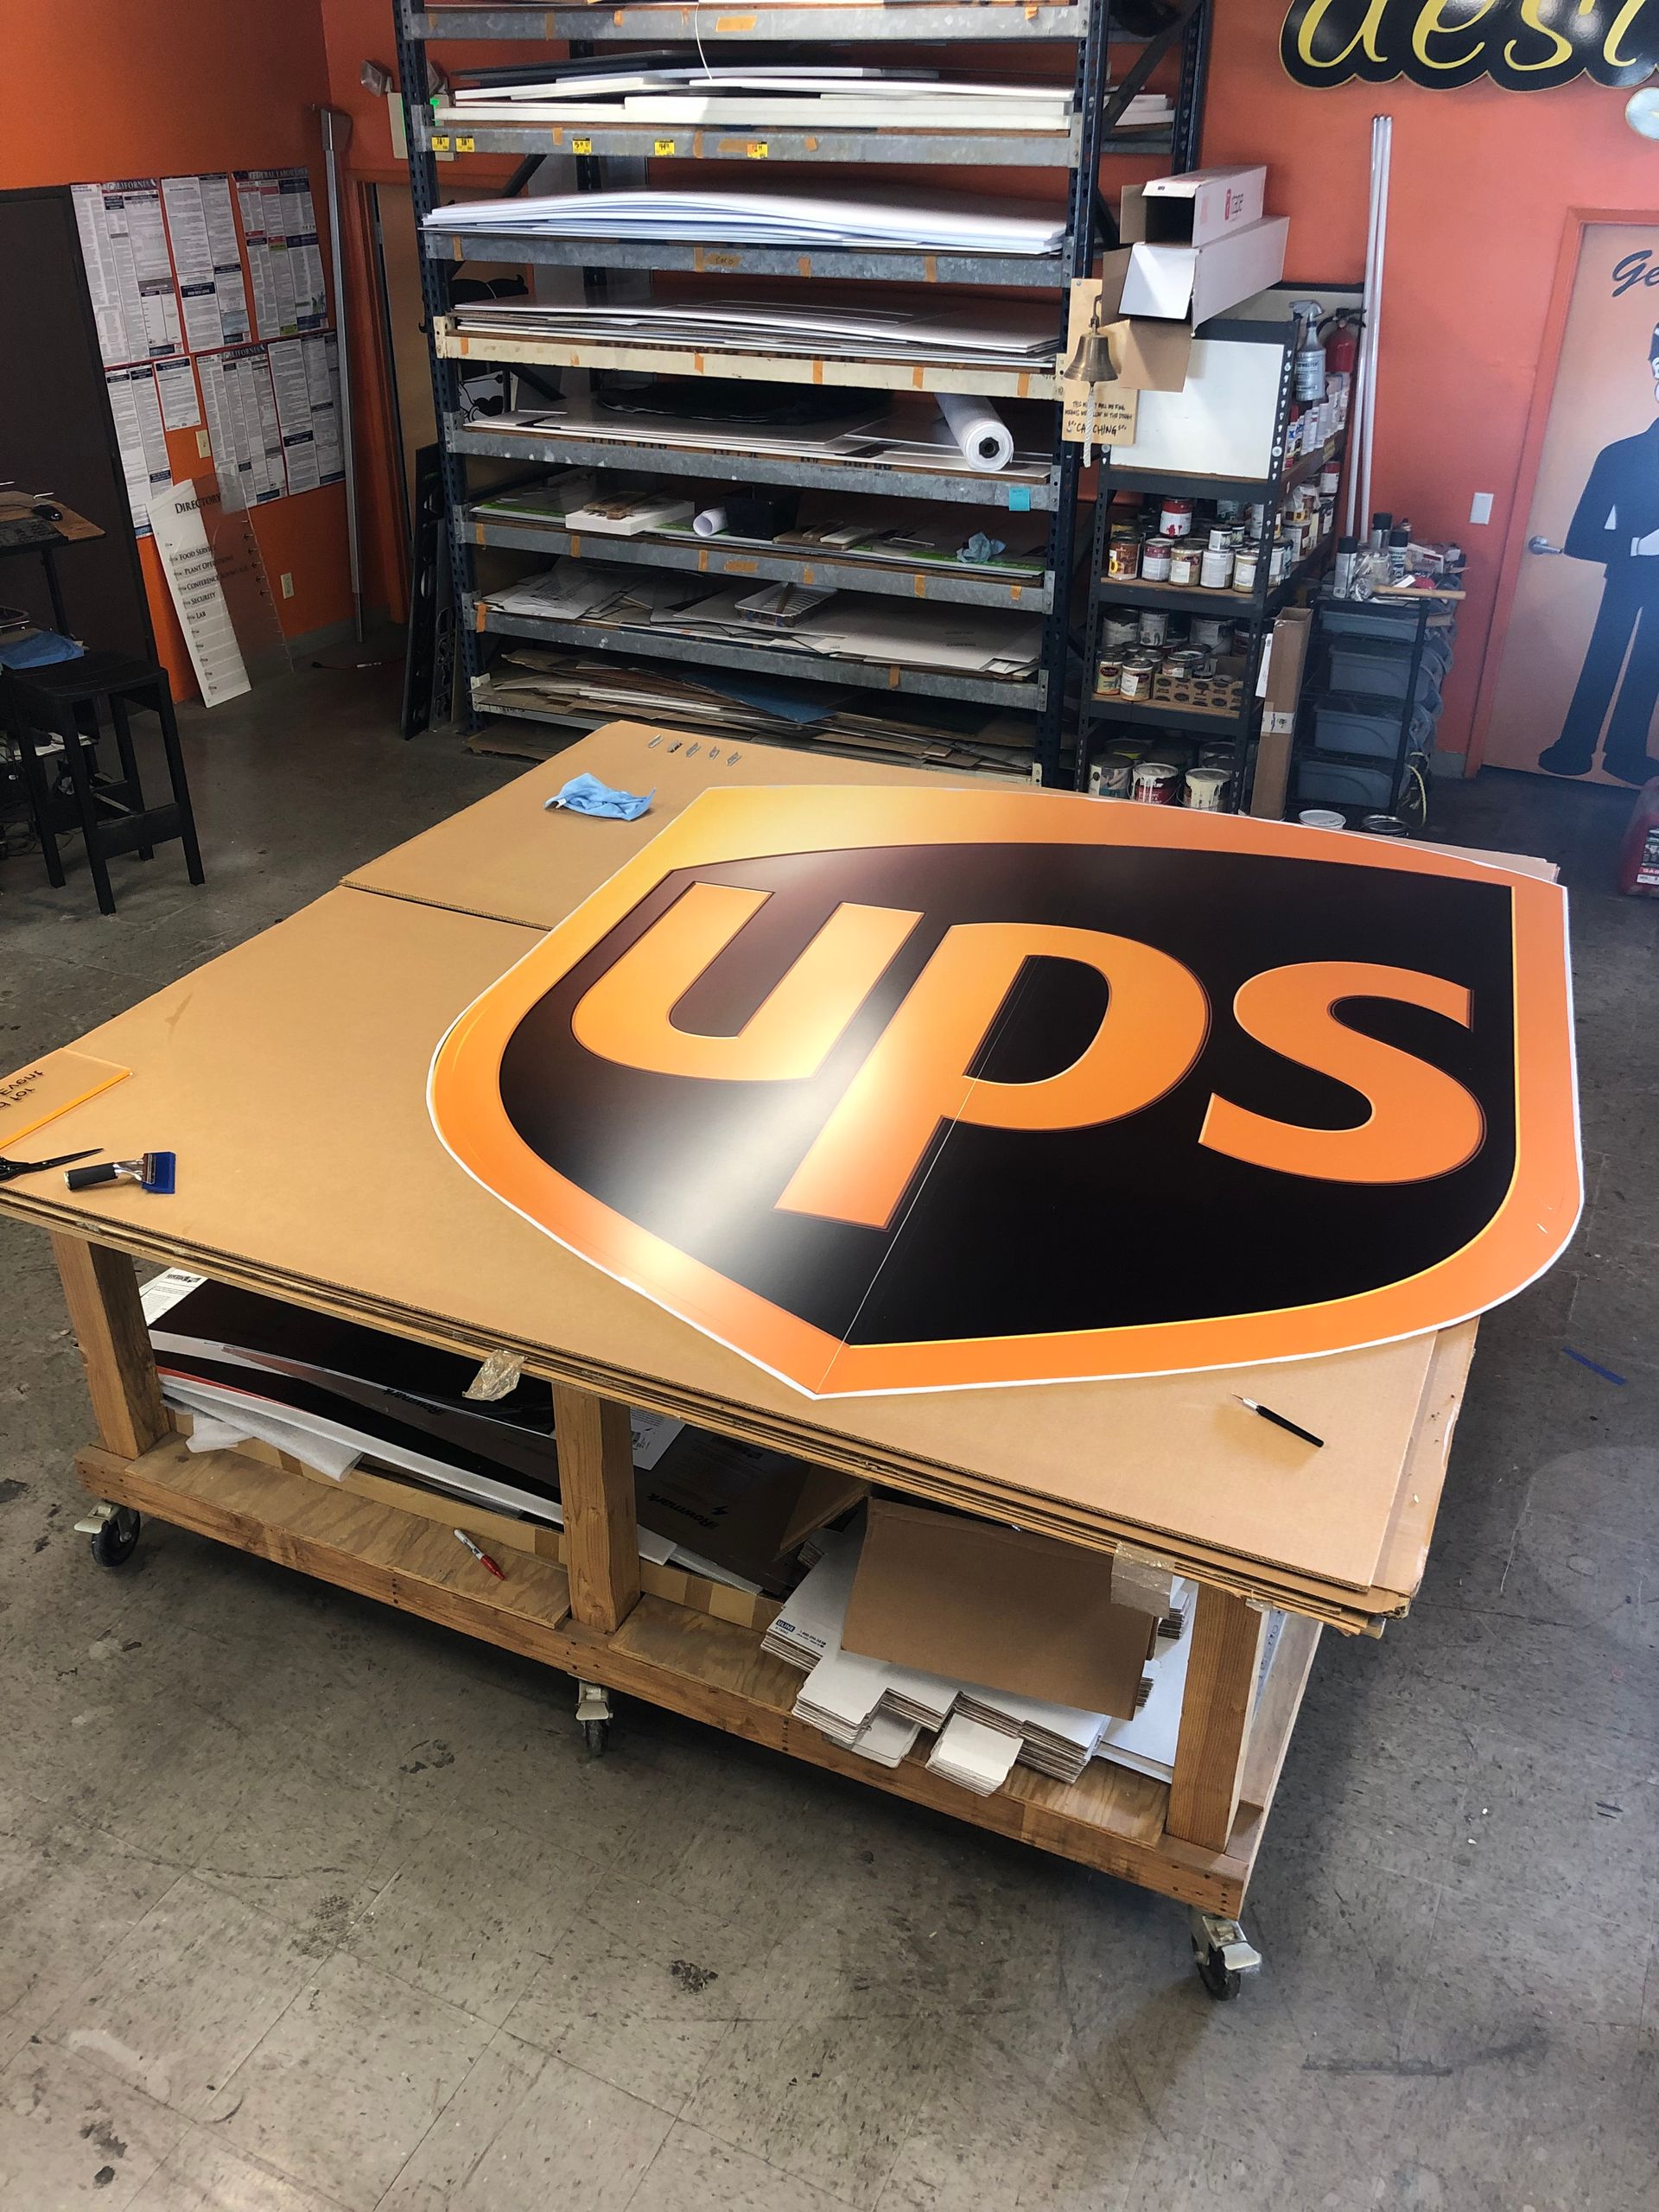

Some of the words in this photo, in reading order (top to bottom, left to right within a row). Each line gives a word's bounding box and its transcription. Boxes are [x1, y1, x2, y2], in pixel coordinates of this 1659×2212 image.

[175, 493, 221, 514] DIRECTORY
[179, 551, 195, 561] FOOD
[184, 566, 201, 575] PLANT
[191, 591, 216, 605] SECURITY
[196, 611, 207, 620] LAB
[571, 881, 1488, 1231] ups
[647, 1493, 719, 1529] Rowmark
[777, 1620, 795, 1631] ULINE
